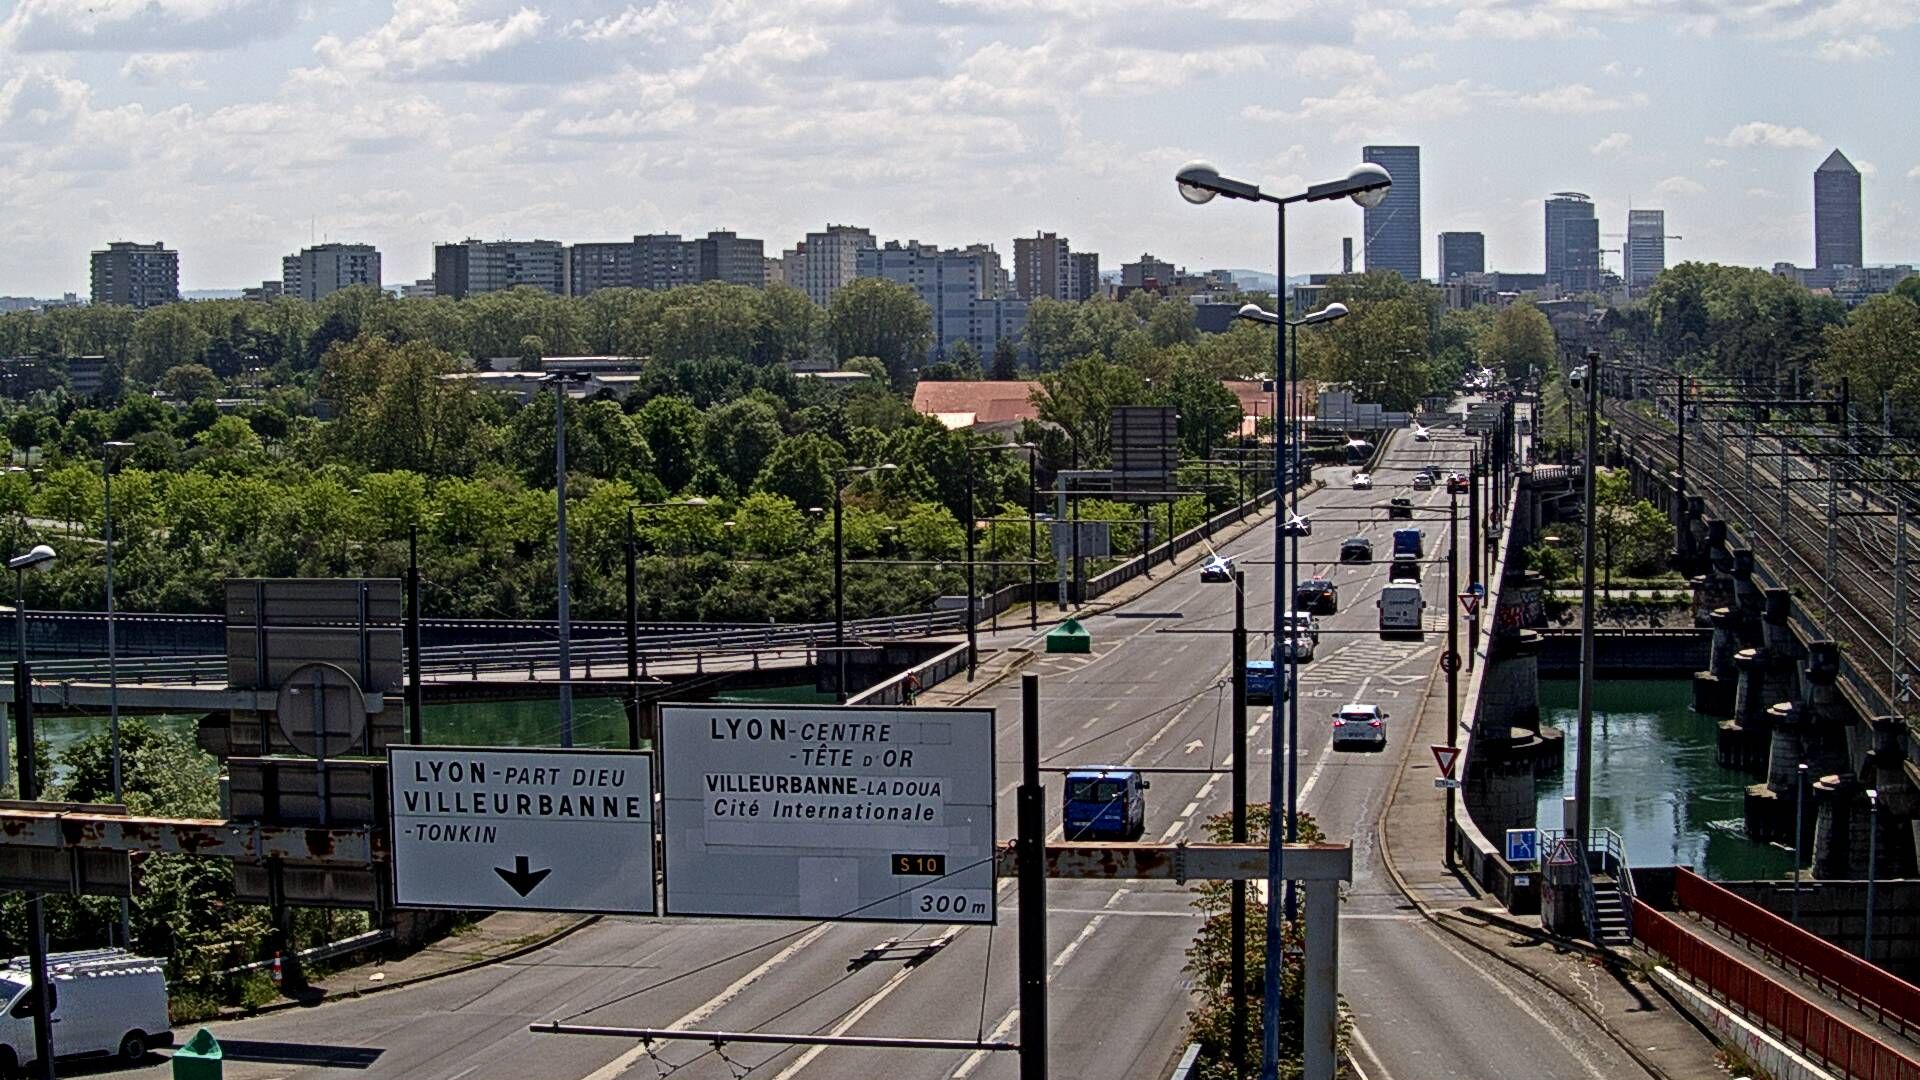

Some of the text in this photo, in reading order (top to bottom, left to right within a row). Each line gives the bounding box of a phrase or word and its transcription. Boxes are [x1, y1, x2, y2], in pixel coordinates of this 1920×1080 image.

[711, 718, 891, 742] LYON-CENTRE
[573, 769, 625, 787] DIEU
[893, 781, 942, 797] DOUA
[404, 791, 641, 818] VILLEURBANNE
[714, 798, 935, 821] Cité Internationale
[919, 895, 986, 914] 300 m
